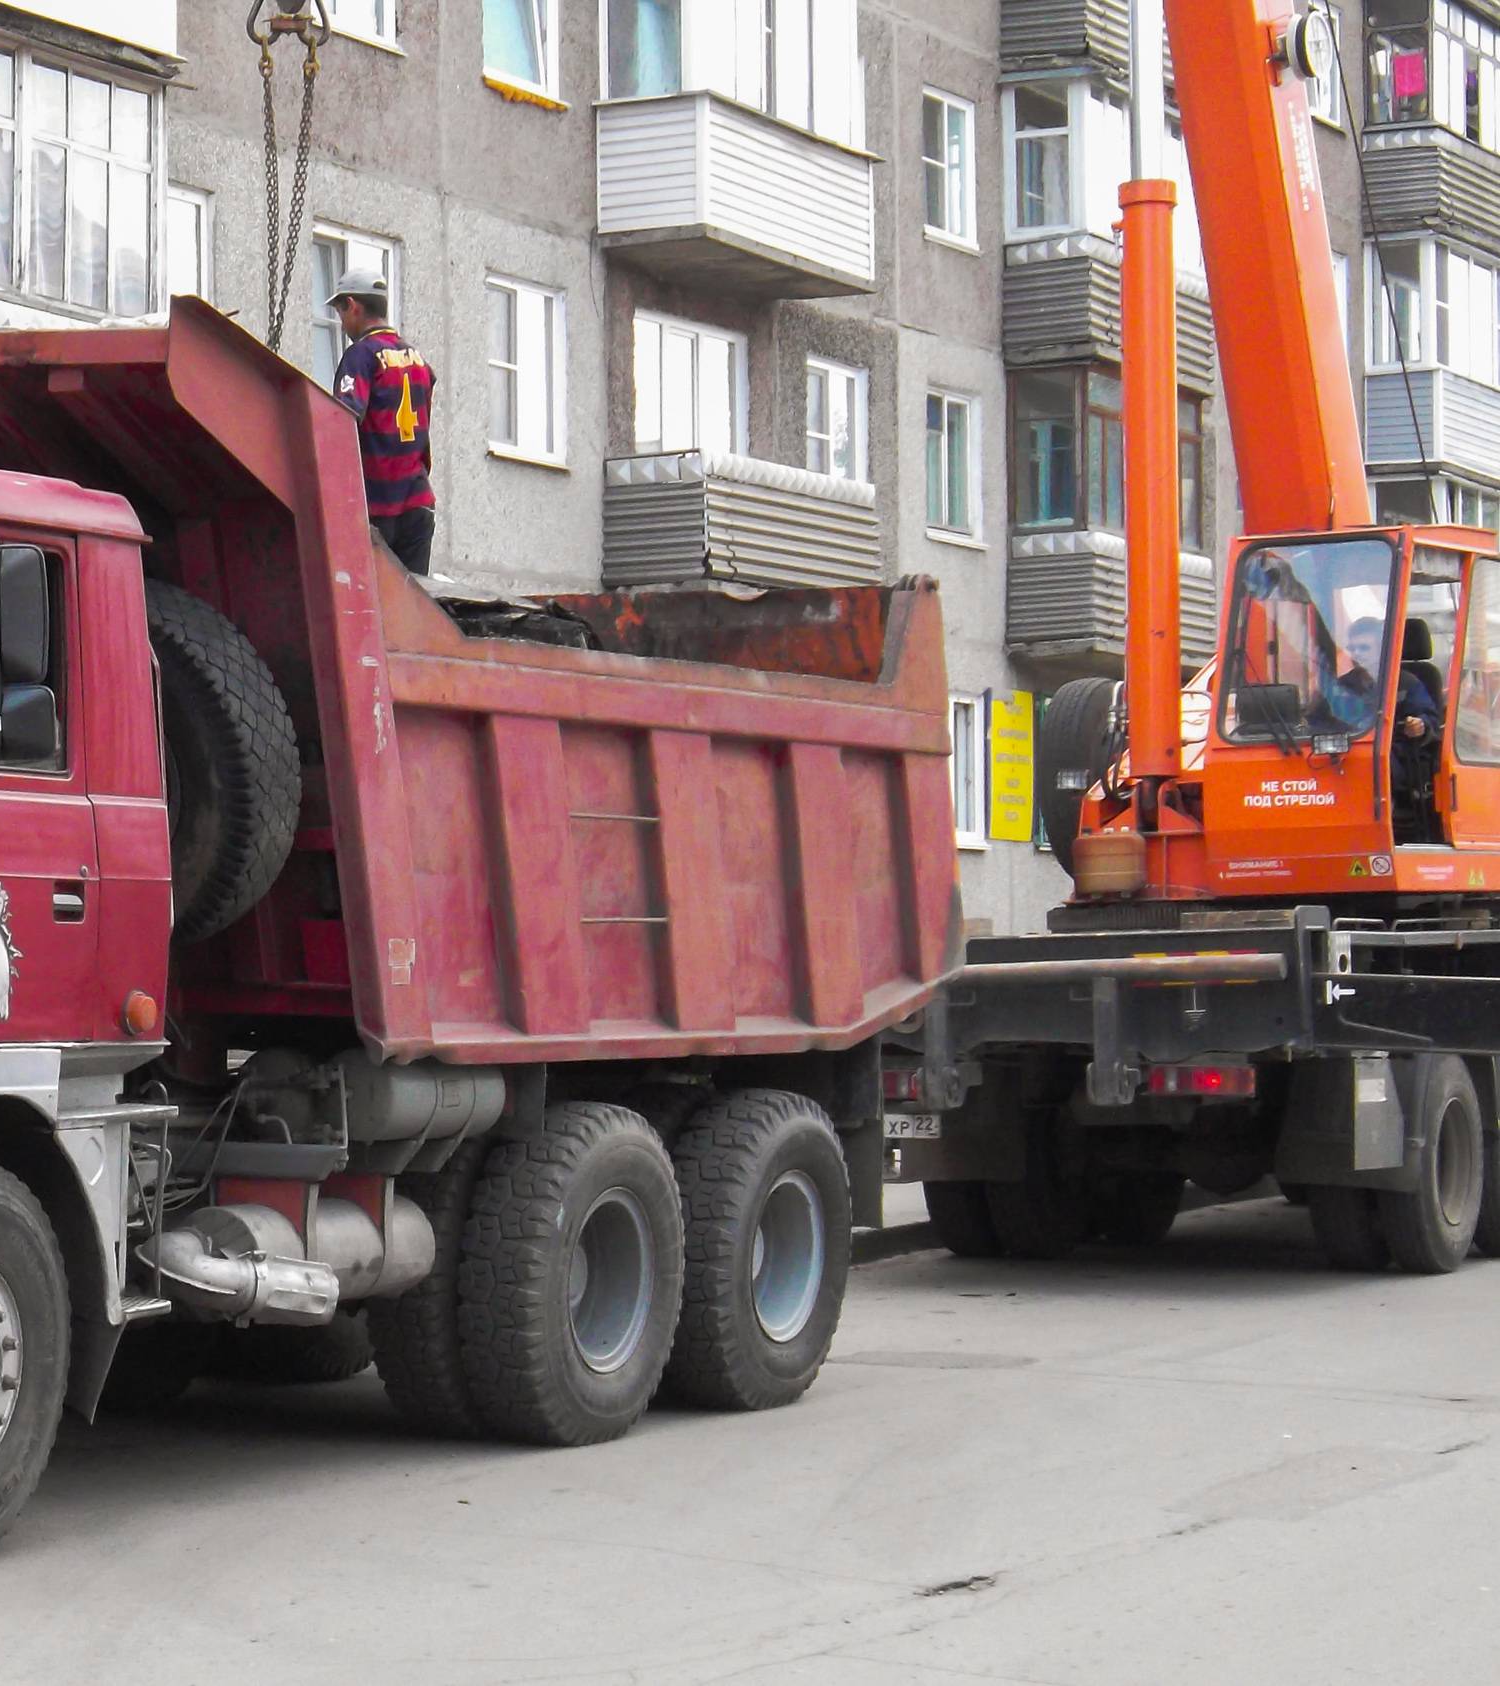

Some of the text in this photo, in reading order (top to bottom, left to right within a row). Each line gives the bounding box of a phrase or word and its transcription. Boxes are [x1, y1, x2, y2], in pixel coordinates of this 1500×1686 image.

[396, 372, 420, 442] 4
[1261, 778, 1317, 792] НЕ СТОЙ
[1244, 792, 1336, 808] ПОД СТРЕЛОЙ
[916, 1116, 933, 1131] 22
